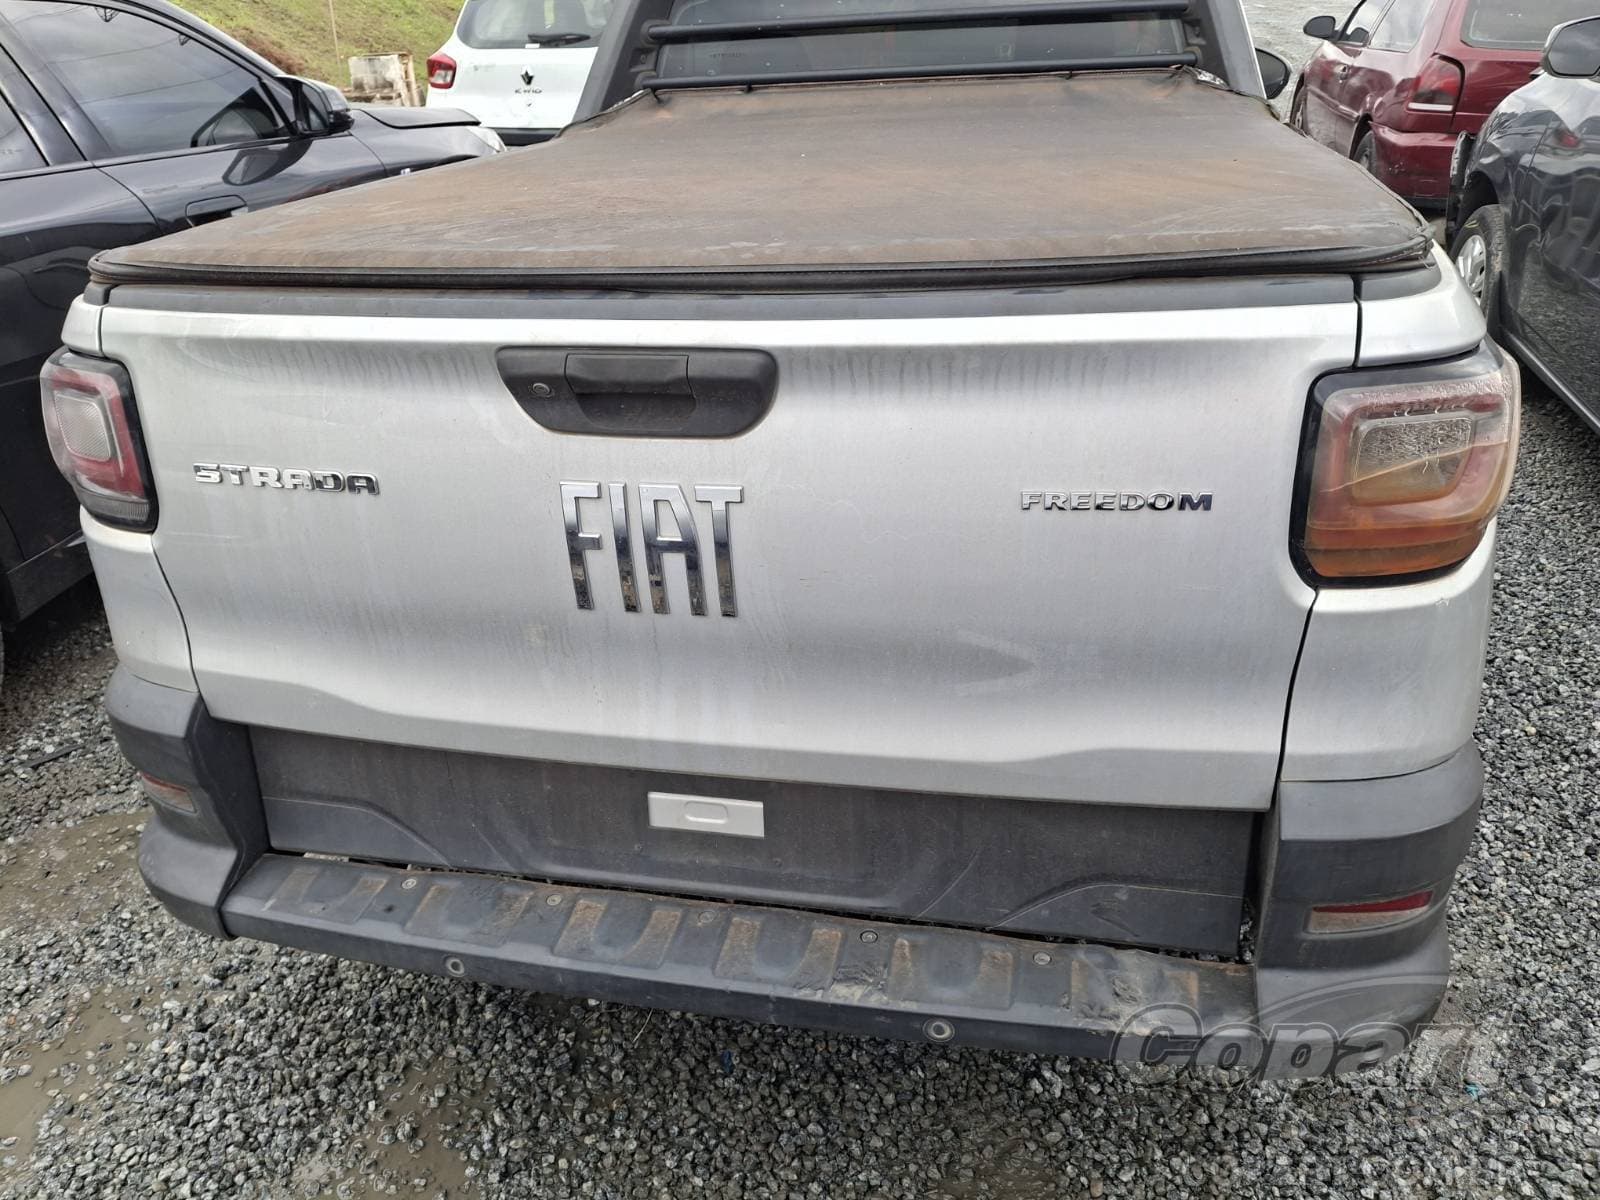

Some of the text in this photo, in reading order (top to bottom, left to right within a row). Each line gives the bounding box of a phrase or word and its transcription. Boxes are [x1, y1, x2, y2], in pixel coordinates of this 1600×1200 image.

[193, 462, 380, 497] STRADA
[1020, 490, 1213, 513] FREEDOM
[559, 480, 745, 618] FIAT
